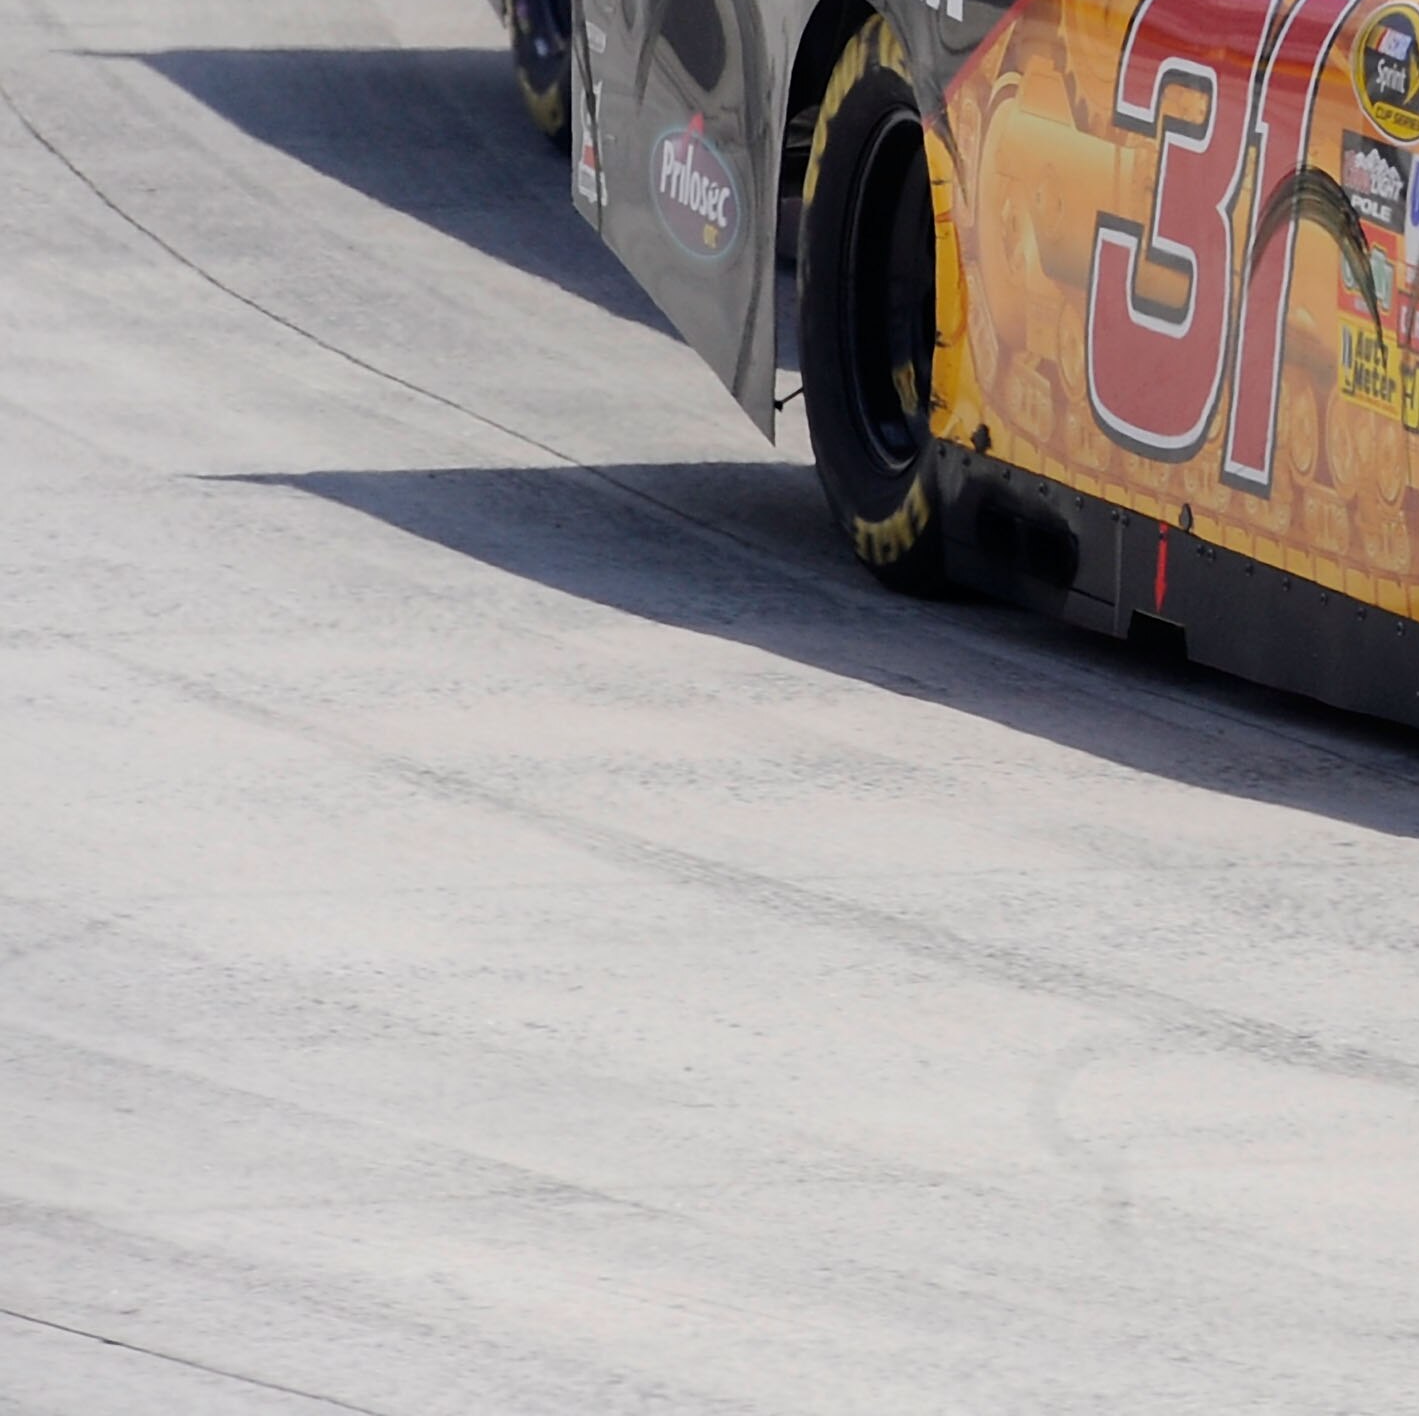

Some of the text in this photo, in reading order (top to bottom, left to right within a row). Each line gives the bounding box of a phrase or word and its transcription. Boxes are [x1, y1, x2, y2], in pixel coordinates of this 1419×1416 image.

[1376, 58, 1407, 94] Sprint
[1375, 105, 1392, 122] CUP
[1351, 195, 1393, 224] POLE
